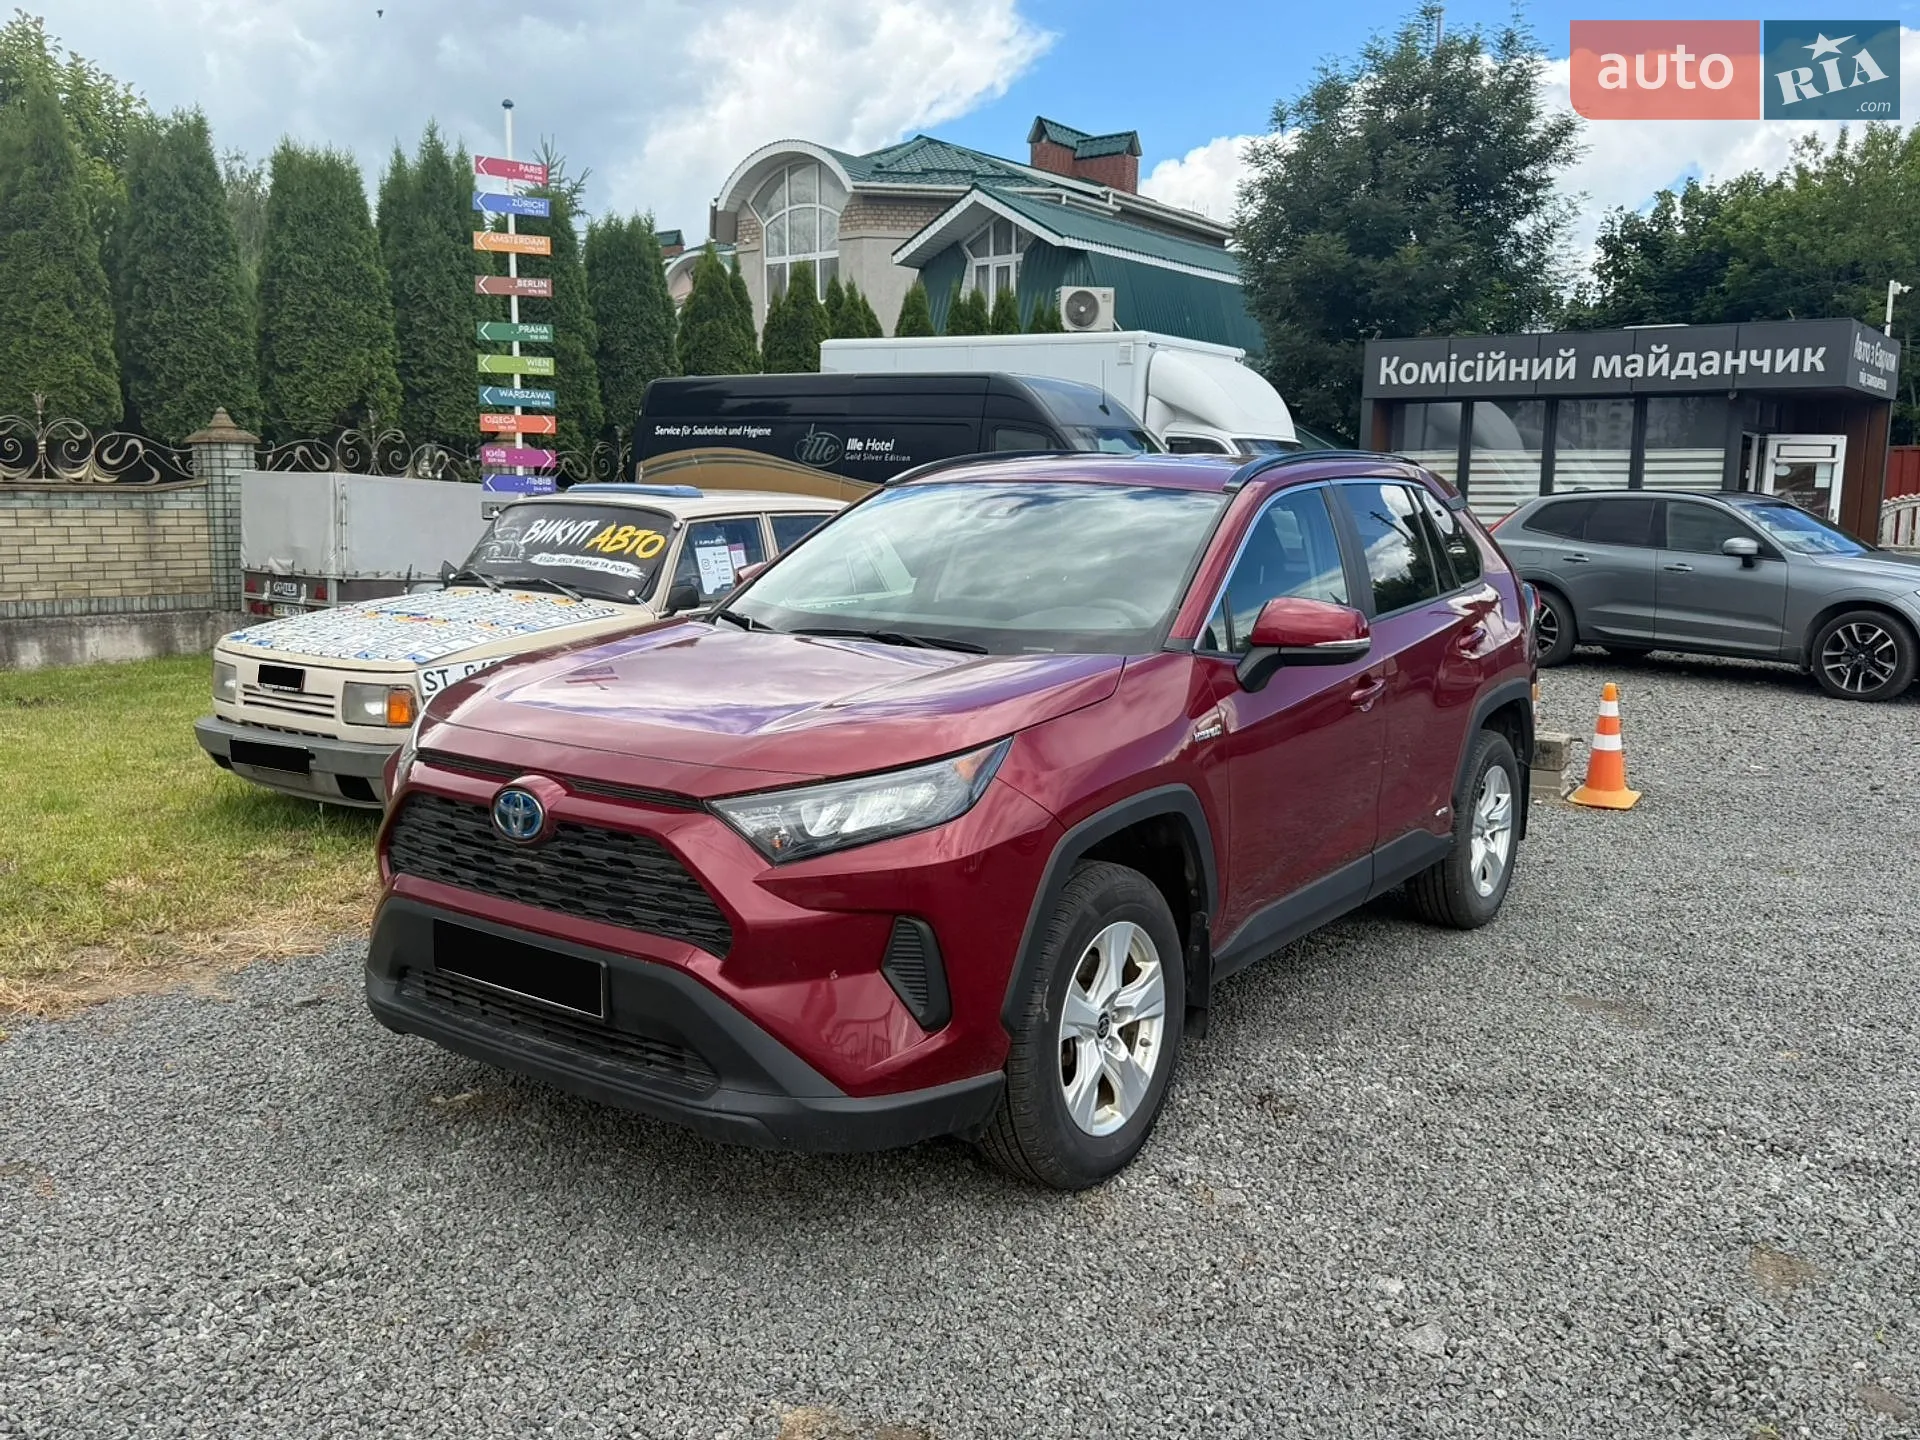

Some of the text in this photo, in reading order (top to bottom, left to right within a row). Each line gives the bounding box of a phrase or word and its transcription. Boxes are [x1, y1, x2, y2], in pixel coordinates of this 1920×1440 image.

[518, 163, 543, 175] PARIS
[511, 198, 545, 210] ZÜRICH
[489, 235, 546, 246] AMSTERDAM
[516, 279, 548, 289] BERLIN
[518, 325, 549, 335] PRAHA
[526, 358, 550, 368] WIEN
[1379, 348, 1577, 386] Комісійний
[1591, 344, 1827, 380] майданчик
[498, 389, 551, 401] WARSZAWA
[484, 415, 517, 425] ОДЕСА
[654, 425, 772, 439] Service für Sauberkeit und Hygiene
[846, 437, 895, 452] Ille Hotel
[485, 449, 507, 459] КИЇВ
[844, 452, 911, 462] Gold Silver Edition
[526, 477, 552, 486] ЛЬВІВ
[520, 517, 667, 559] ВИКУП АВТО
[609, 563, 631, 574] РОКУ
[422, 667, 449, 692] ST
